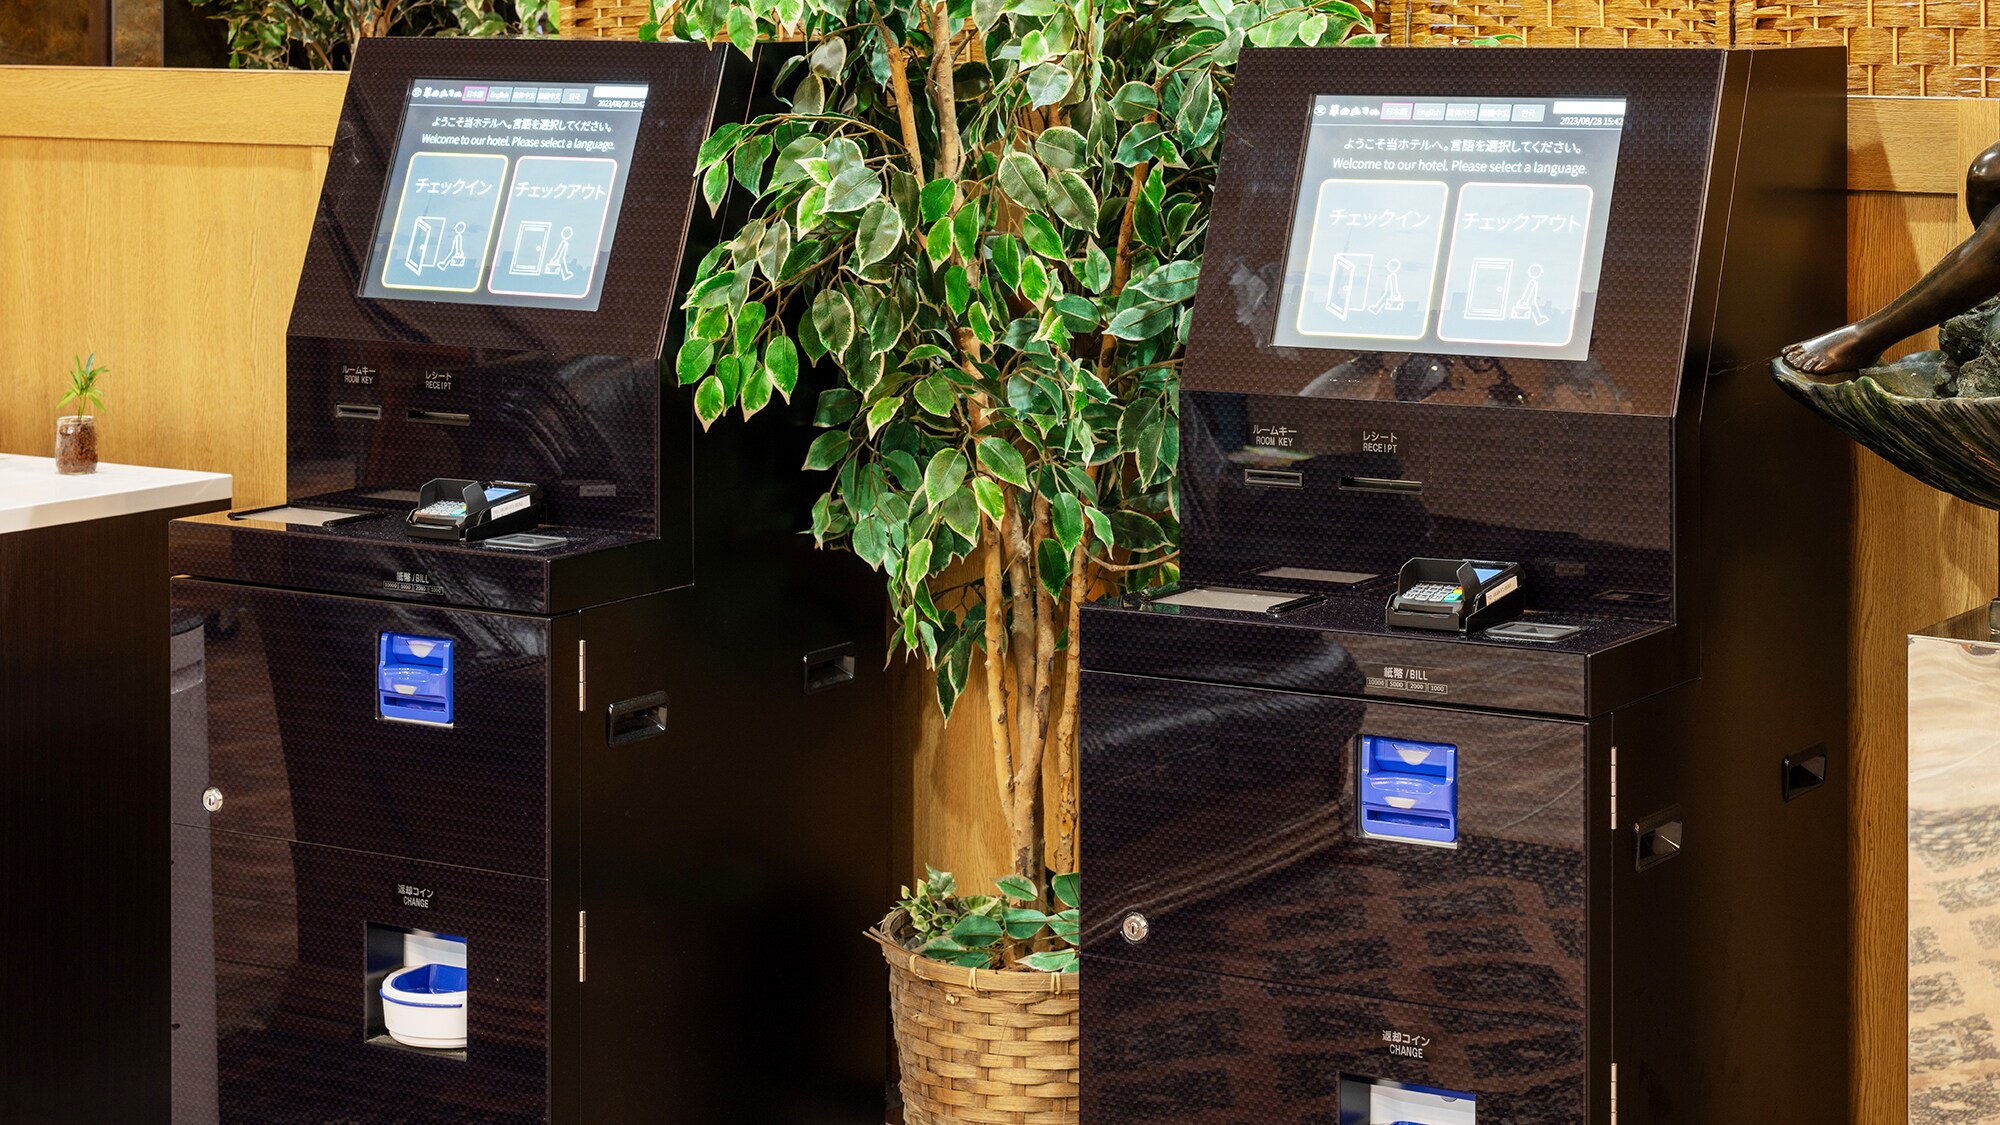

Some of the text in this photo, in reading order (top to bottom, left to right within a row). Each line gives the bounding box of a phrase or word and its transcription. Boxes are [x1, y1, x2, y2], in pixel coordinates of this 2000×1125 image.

[1416, 108, 1441, 118] English
[1559, 116, 1623, 126] 2023/08/28 15:42
[421, 134, 615, 152] Welcome to our hotel. Please select a language.
[1343, 137, 1582, 154] ようこそ当ホテルへ。言語を選択してください。
[1332, 157, 1588, 177] Welcome to our hotel. Please select a language.
[414, 177, 493, 196] チェックイン
[514, 181, 606, 201] チェックアウト
[1329, 208, 1431, 228] チェックイン
[1461, 211, 1583, 233] チェックアウト
[342, 365, 376, 375] ルームキー
[425, 370, 452, 381] レシート
[344, 375, 374, 385] ROOM KEY
[425, 381, 452, 390] RECEIPT
[1252, 424, 1297, 436] ルームキー
[1255, 436, 1294, 447] ROOM KEY
[1362, 431, 1398, 443] レシート
[1362, 443, 1398, 454] RECEIPT
[397, 884, 434, 898] 返却コイン
[403, 895, 429, 908] CHANGE
[1382, 1029, 1430, 1046] 返却コイン
[1389, 1043, 1424, 1059] CHANGE
